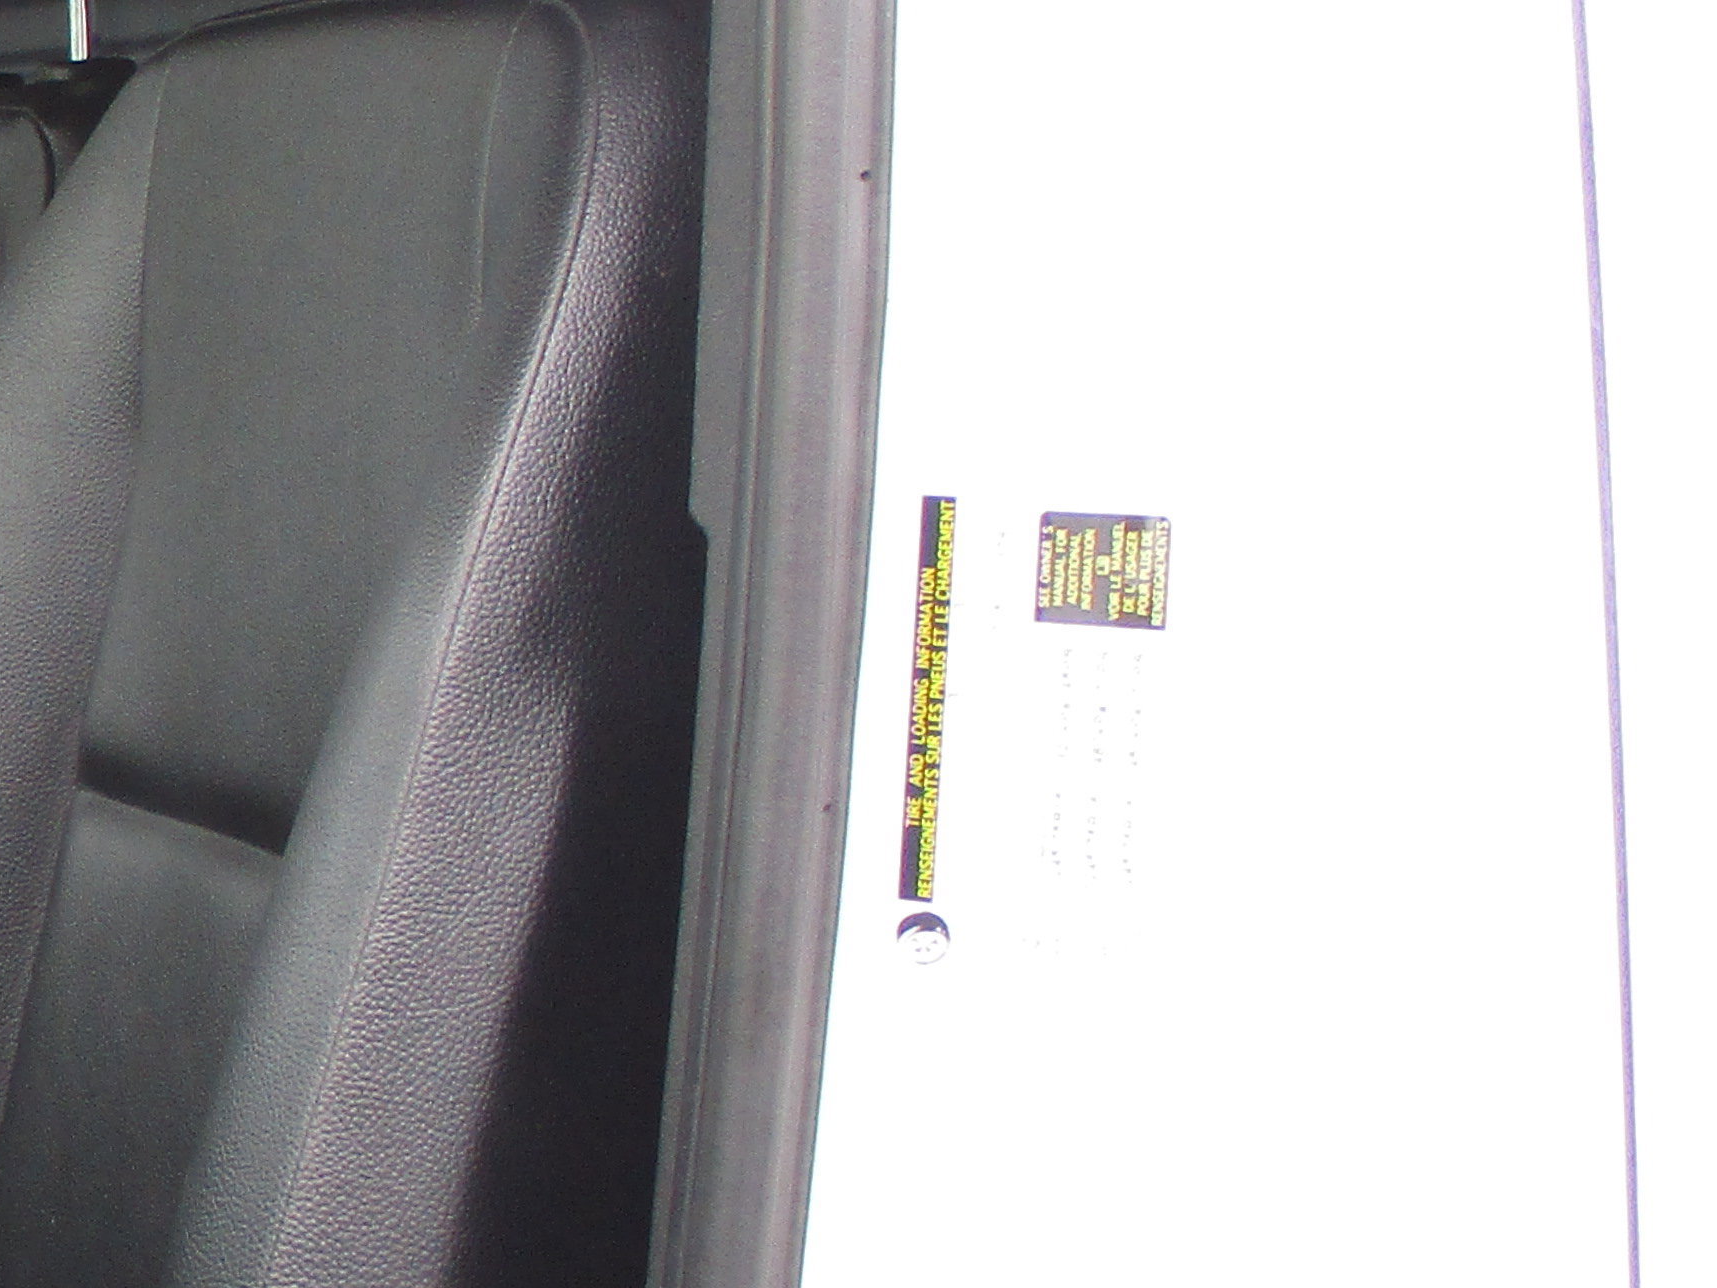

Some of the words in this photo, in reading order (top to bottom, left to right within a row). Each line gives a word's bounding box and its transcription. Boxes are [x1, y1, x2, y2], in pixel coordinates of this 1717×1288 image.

[935, 499, 956, 602] CHARGEMENT
[1055, 529, 1069, 553] FOR
[1111, 520, 1126, 572] MANUEL
[1141, 530, 1154, 547] DE
[1052, 555, 1067, 607] MANUAL
[1066, 532, 1083, 605] ADDITIONAL
[1080, 528, 1097, 611] INFORMATION
[1109, 574, 1123, 590] LE
[1139, 550, 1153, 581] PLUS
[1151, 520, 1170, 626] RENSEIGNEMENTS
[935, 604, 950, 624] LE
[1038, 588, 1052, 608] SEE
[1108, 592, 1122, 621] VOIR
[1122, 596, 1136, 613] DE
[1137, 583, 1151, 617] POUR
[916, 567, 936, 670] INFORMATION
[932, 626, 948, 647] ET
[929, 650, 947, 701] PNEUS
[911, 678, 929, 745] LOADING
[928, 702, 943, 731] LES
[925, 735, 941, 764] SUR
[909, 754, 924, 788] AND
[906, 796, 922, 828] TIRE
[917, 767, 939, 899] RENSEIGNEMENTS
